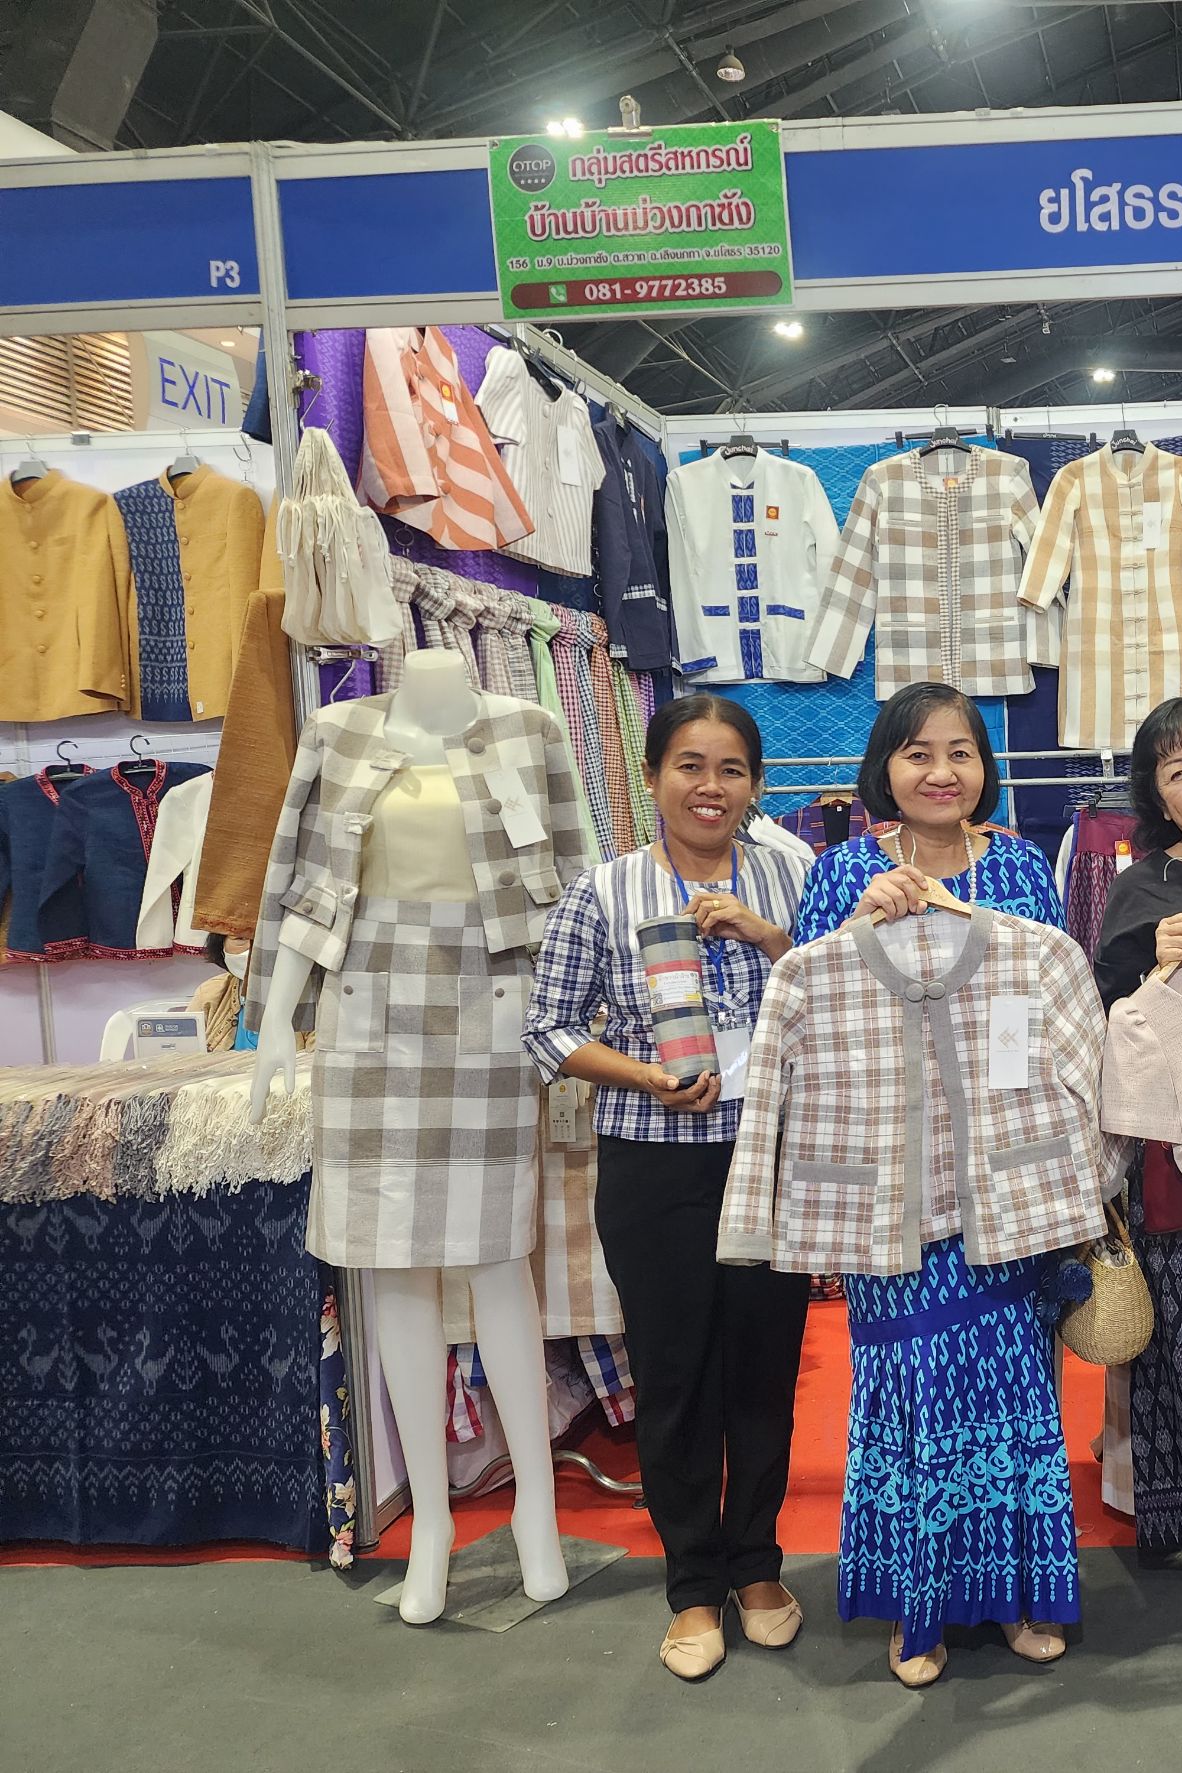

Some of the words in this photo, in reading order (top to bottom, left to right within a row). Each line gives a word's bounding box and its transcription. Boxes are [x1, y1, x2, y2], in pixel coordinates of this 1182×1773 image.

[512, 159, 551, 172] OTOP
[570, 134, 750, 185] กลุ่มสตรีสหกรณ์
[509, 259, 529, 270] 156
[746, 245, 780, 256] 35120
[209, 260, 241, 289] P3
[584, 276, 727, 301] 081-9772385
[158, 356, 232, 425] EXIT
